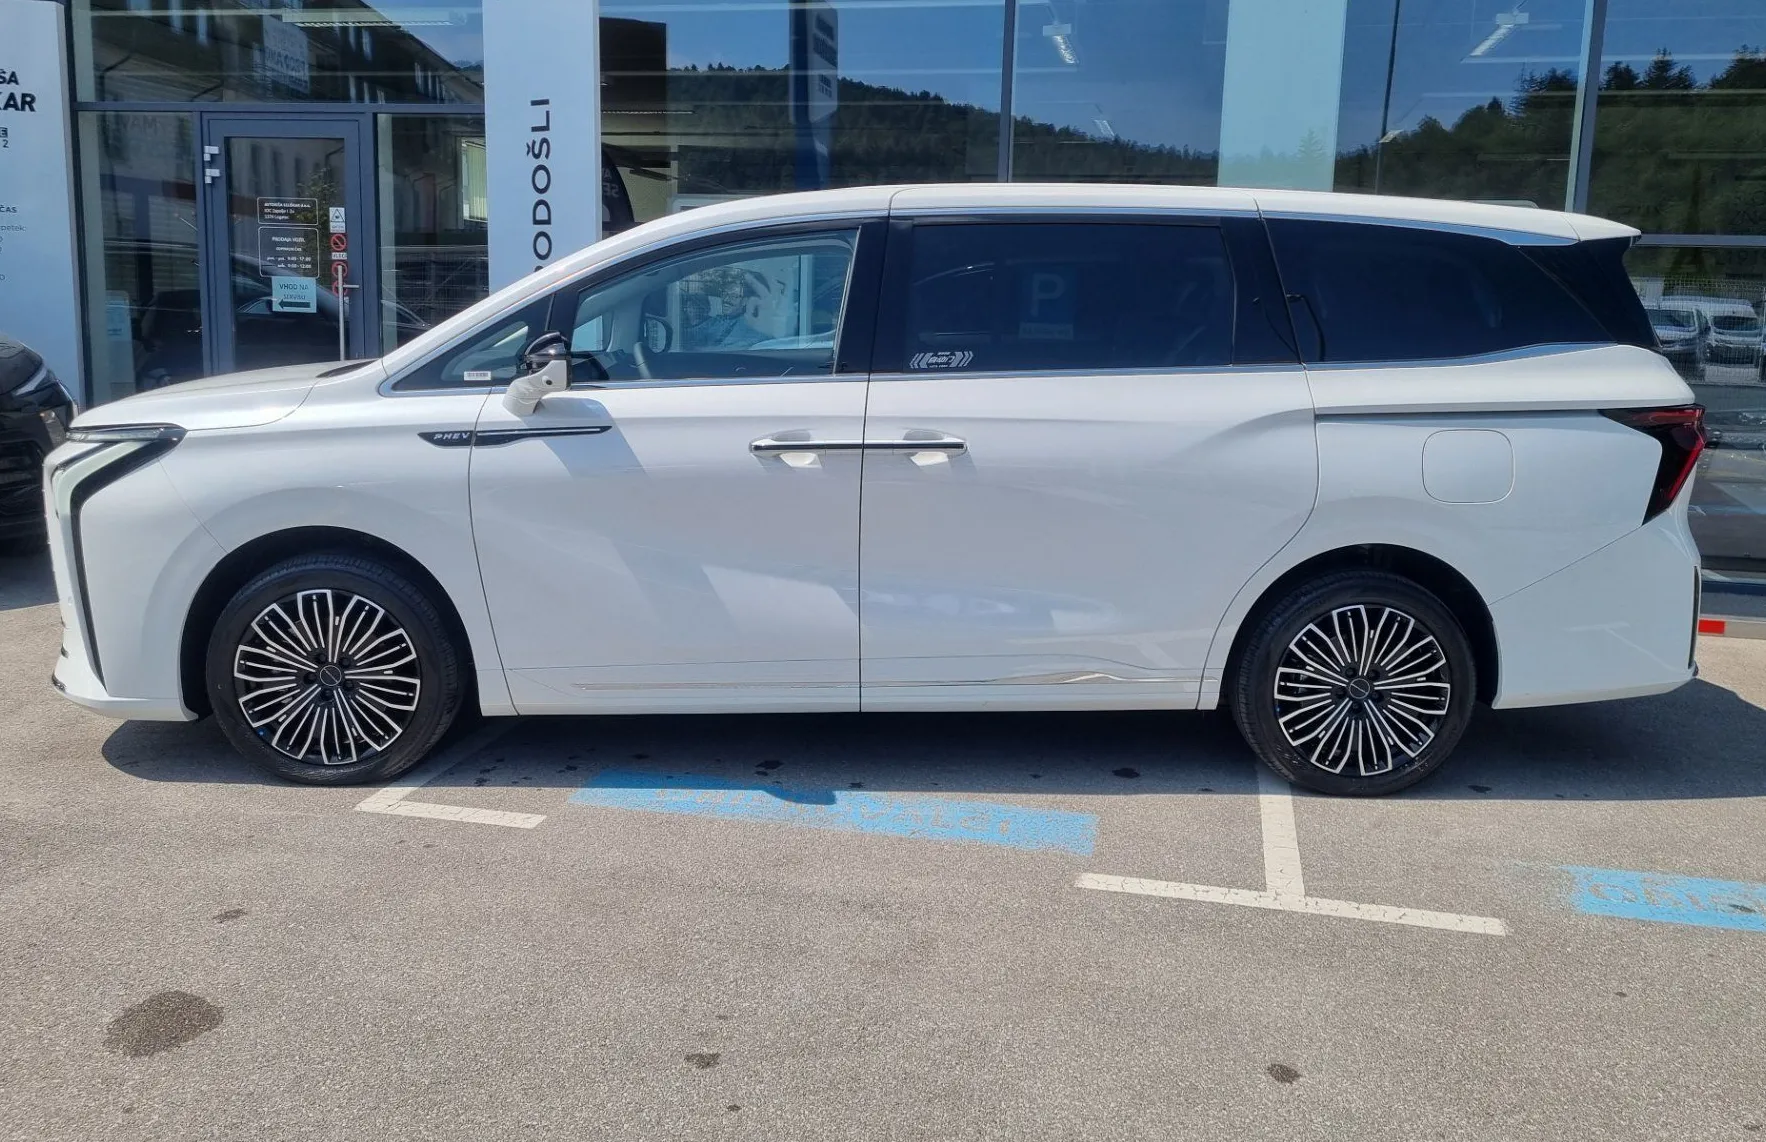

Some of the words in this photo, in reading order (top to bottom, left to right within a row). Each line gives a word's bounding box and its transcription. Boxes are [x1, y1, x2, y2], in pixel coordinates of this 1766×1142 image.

[0, 91, 36, 112] AR
[526, 98, 552, 273] ODOŠLI
[1030, 273, 1066, 317] P
[433, 432, 470, 440] PHEV
